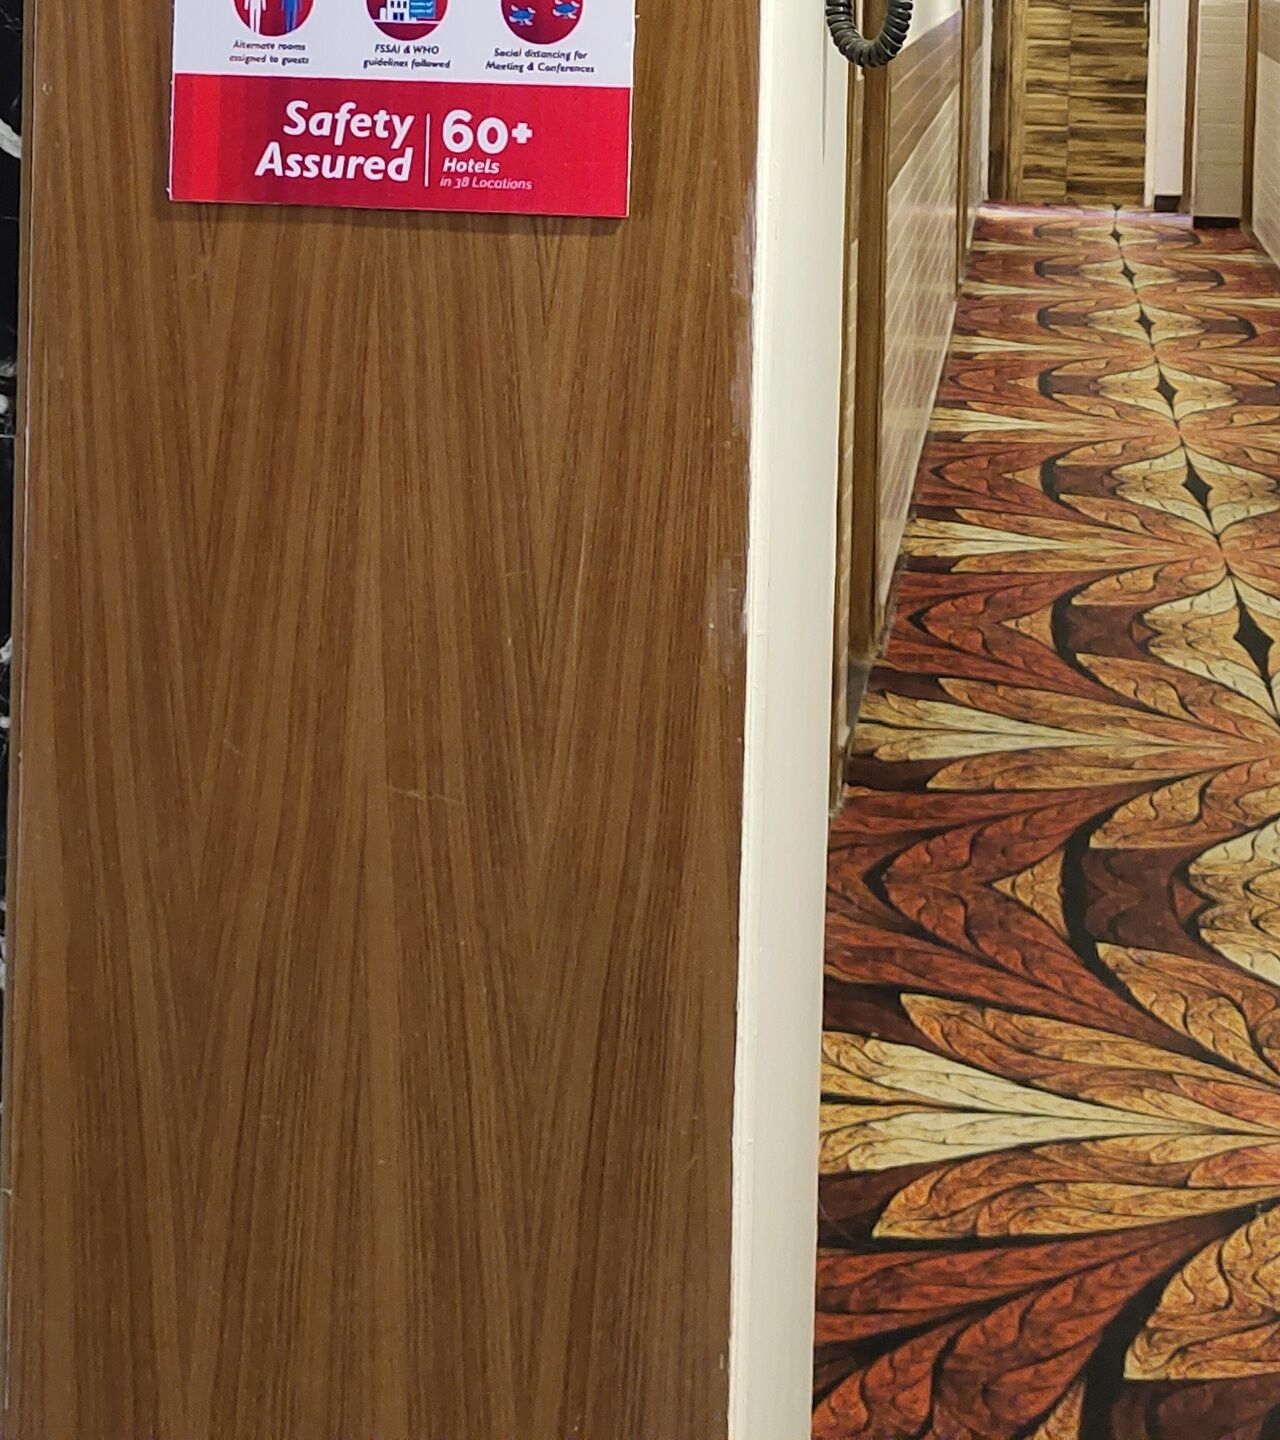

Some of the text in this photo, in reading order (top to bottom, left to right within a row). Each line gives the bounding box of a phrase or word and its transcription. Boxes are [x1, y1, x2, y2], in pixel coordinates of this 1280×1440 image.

[233, 40, 306, 51] Alternate rooms
[374, 44, 439, 54] FSSAI & WHO
[229, 54, 309, 66] assigned to guests
[494, 47, 588, 61] Social distancing for
[363, 57, 451, 70] guidelines followed
[485, 60, 595, 74] Meeting & Conferences
[282, 100, 415, 149] Safety
[442, 109, 533, 154] 60+
[255, 141, 414, 182] Assured
[442, 157, 500, 174] Hotels
[440, 176, 532, 190] in 38 Locations
